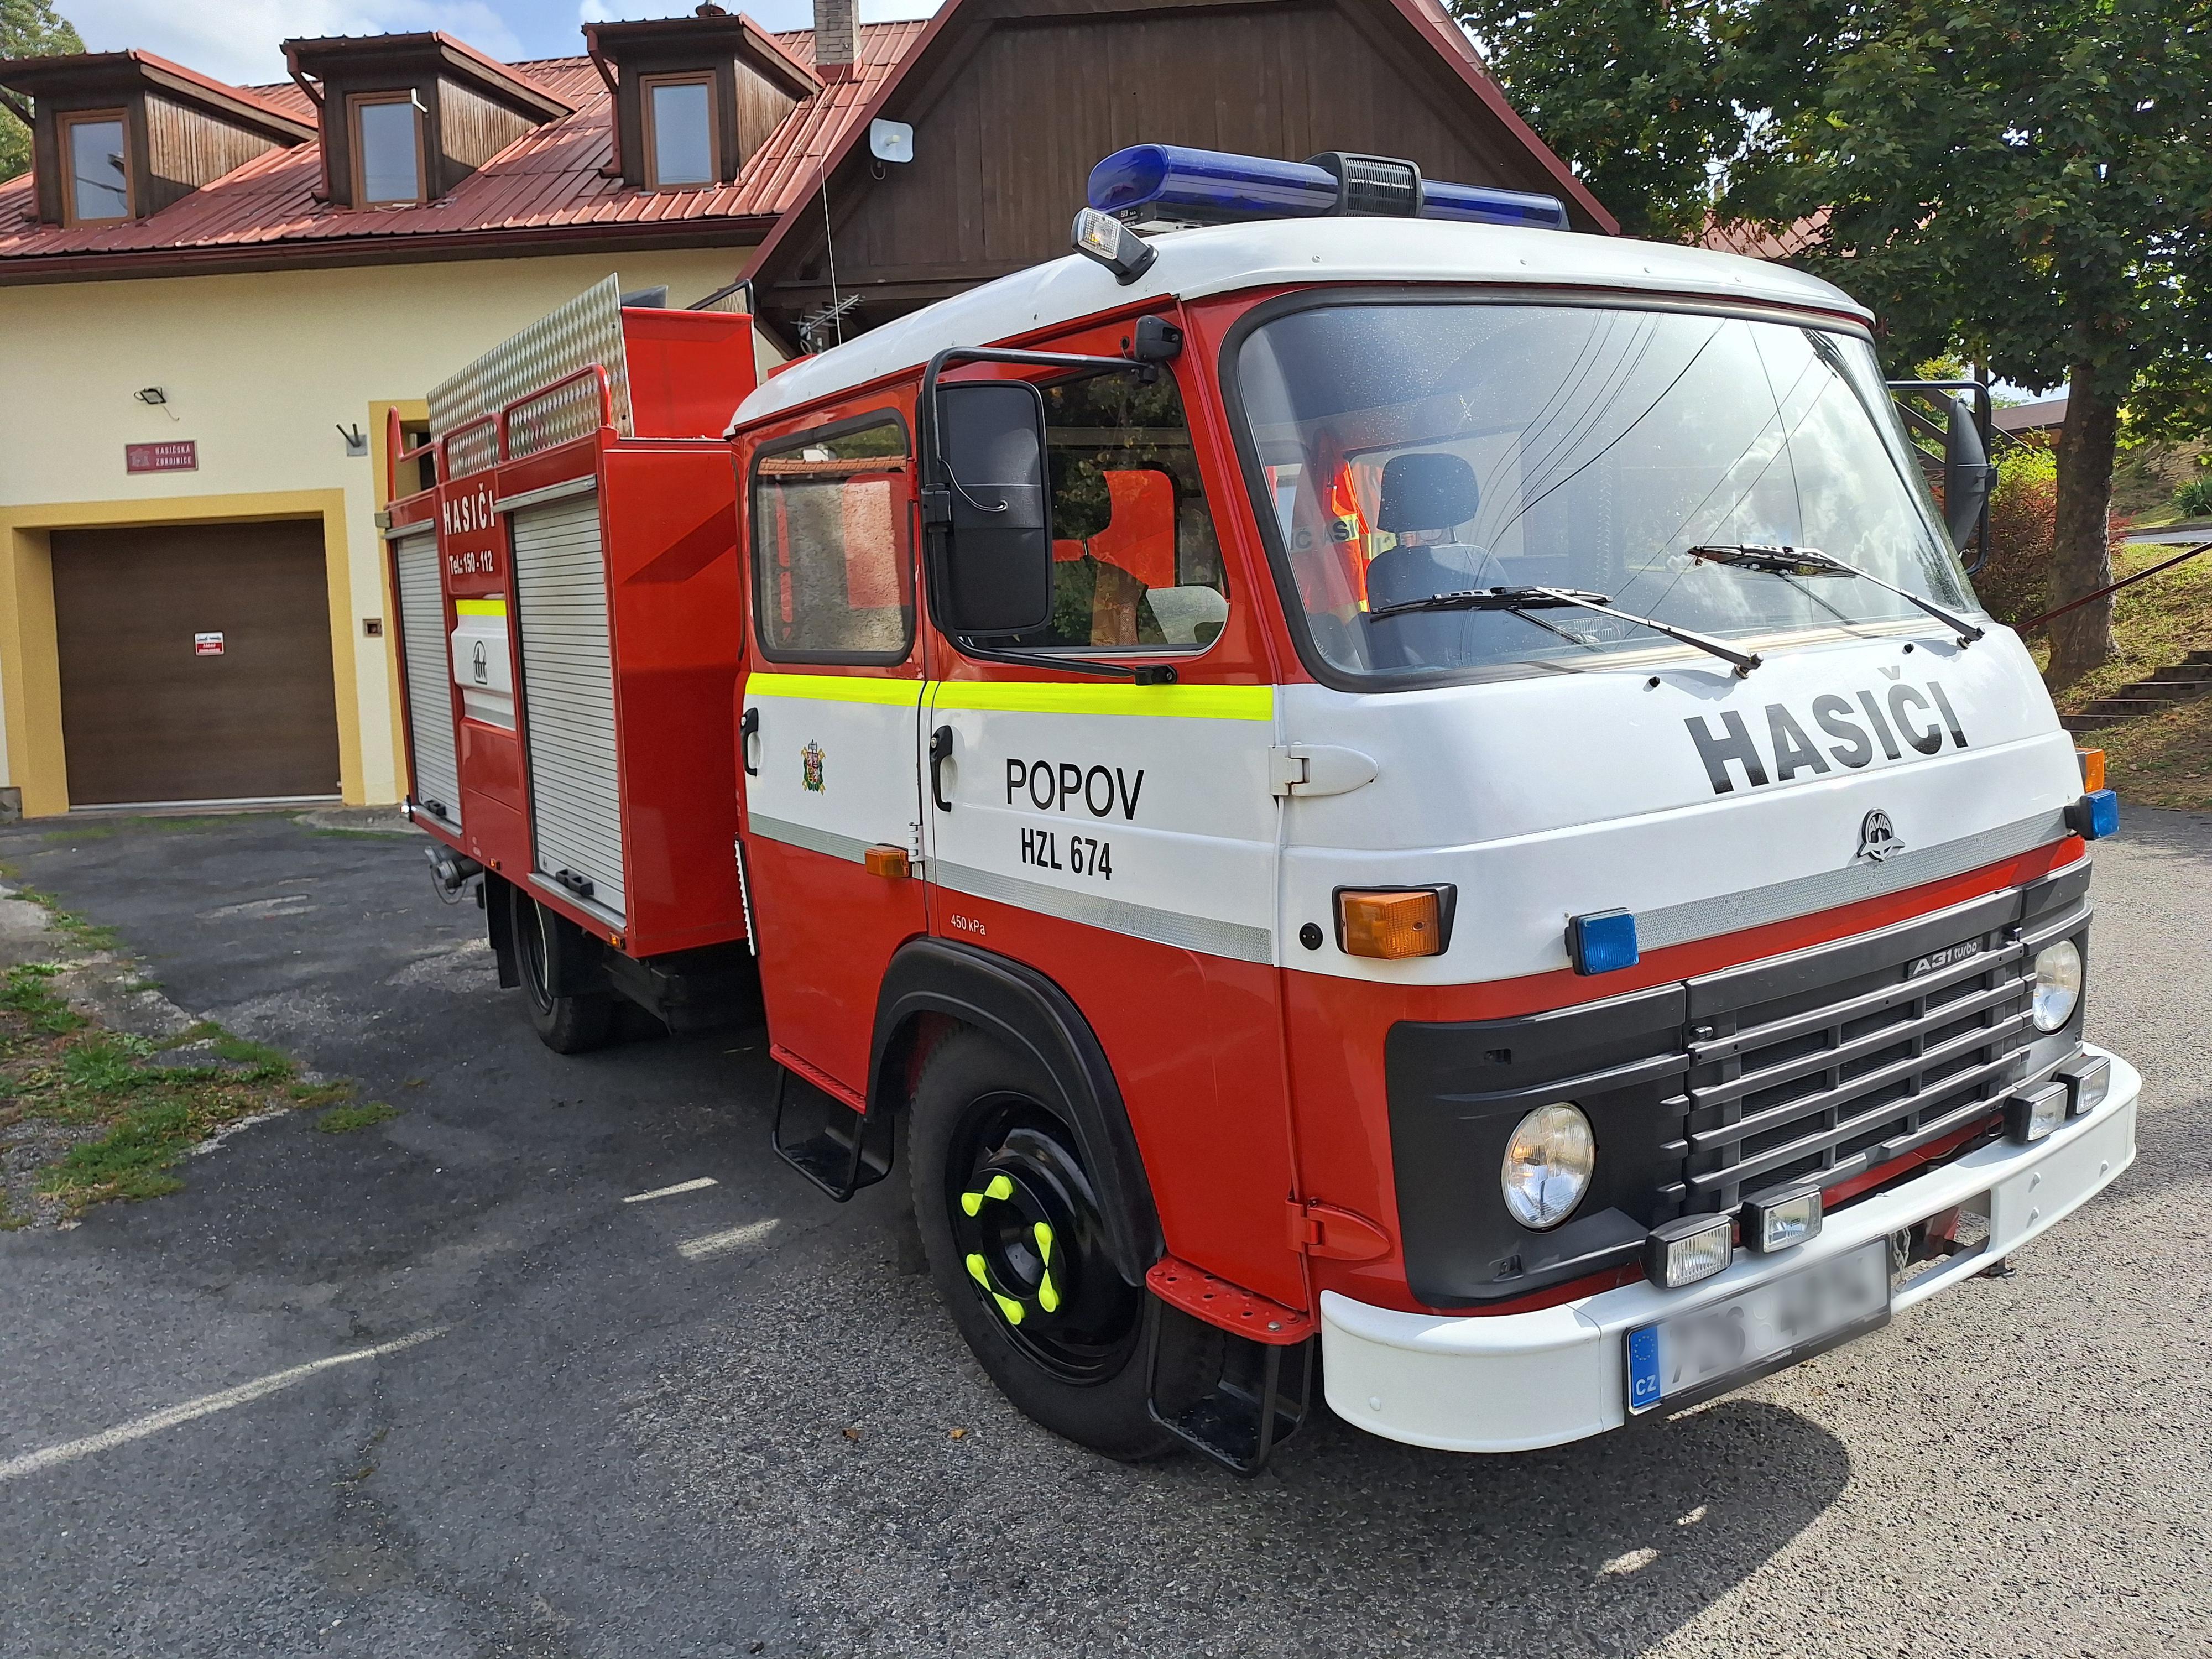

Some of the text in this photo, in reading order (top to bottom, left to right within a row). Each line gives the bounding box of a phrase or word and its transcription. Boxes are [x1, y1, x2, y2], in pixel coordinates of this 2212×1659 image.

[155, 444, 190, 456] HASIČSKÁ
[155, 456, 192, 467] ZBROJNICE
[443, 482, 495, 535] HASIČI
[463, 551, 475, 573] 150
[480, 550, 493, 572] 112
[1683, 665, 1969, 795] HASIČI
[1006, 758, 1144, 820] POPOV
[1869, 814, 1892, 842] AVIA
[1021, 827, 1112, 880] HZL 674
[951, 914, 986, 936] 450 kPa
[1912, 941, 1978, 975] A31 turbo
[1636, 1374, 1656, 1395] CZ
